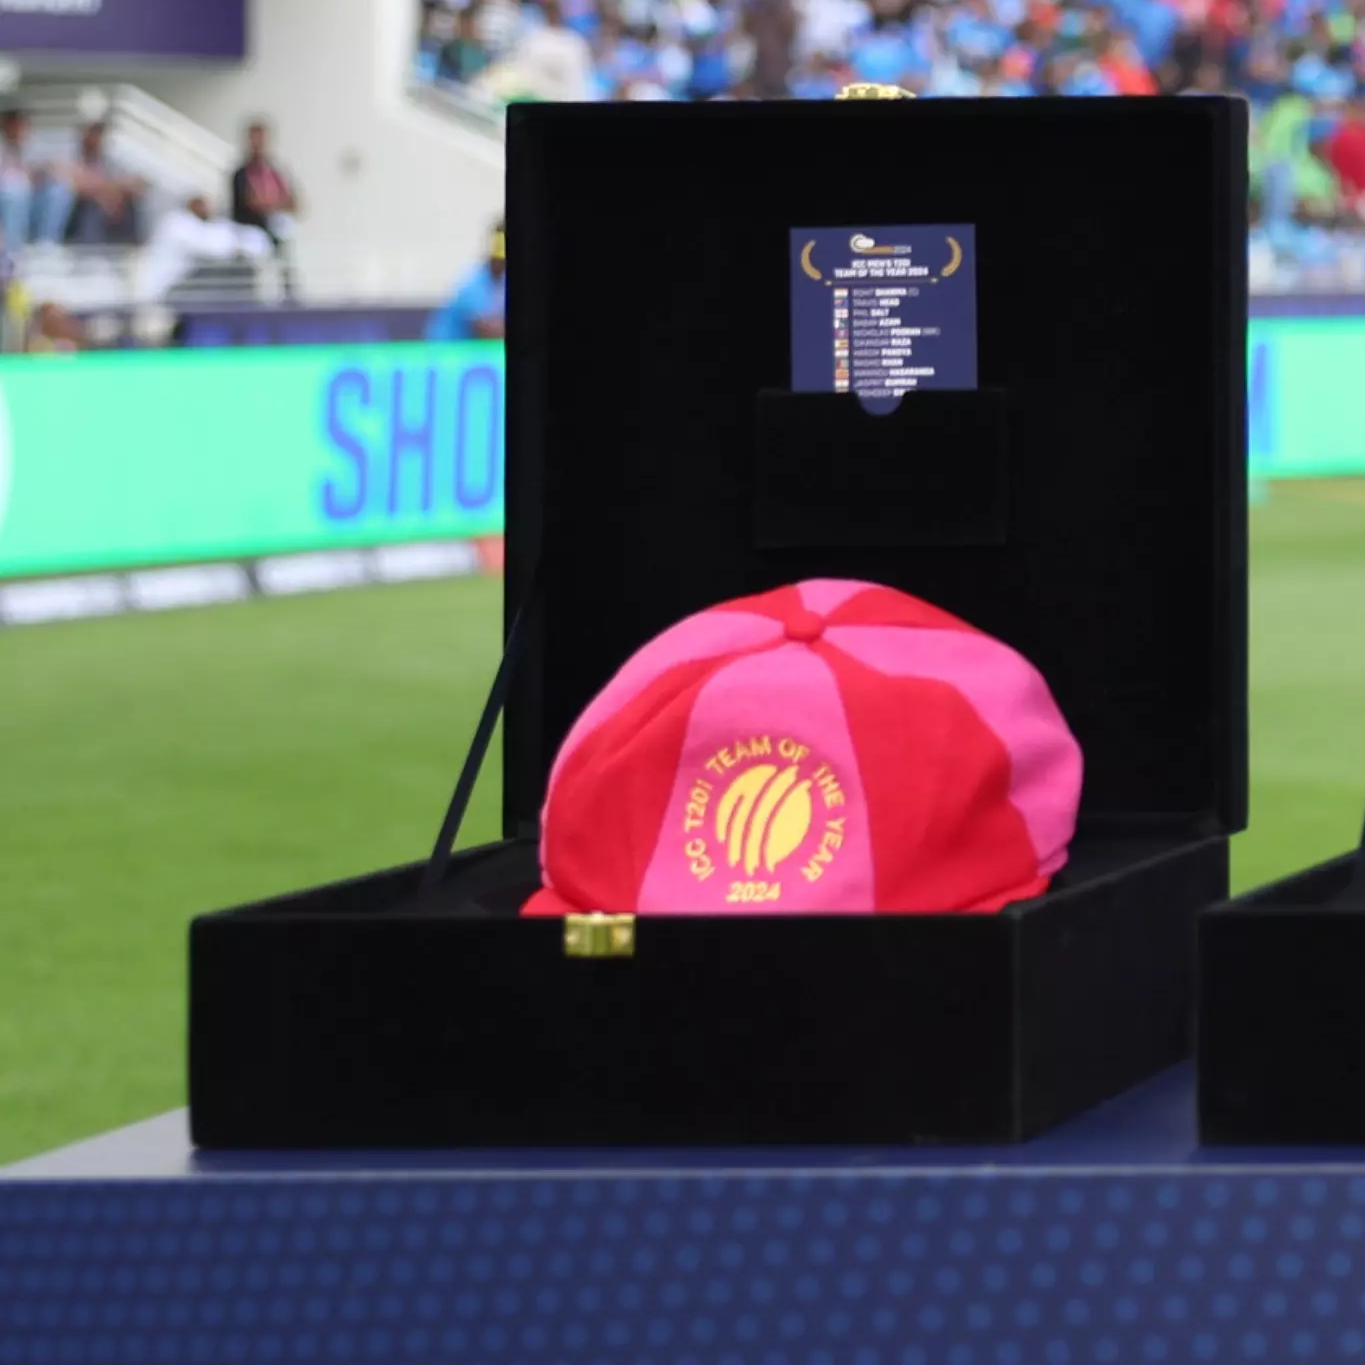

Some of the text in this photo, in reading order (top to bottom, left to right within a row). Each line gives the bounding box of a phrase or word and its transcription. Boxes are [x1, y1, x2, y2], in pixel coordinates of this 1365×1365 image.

[684, 735, 847, 883] ICC T20I TEAM OF THE YEAR
[725, 881, 782, 904] 2024
